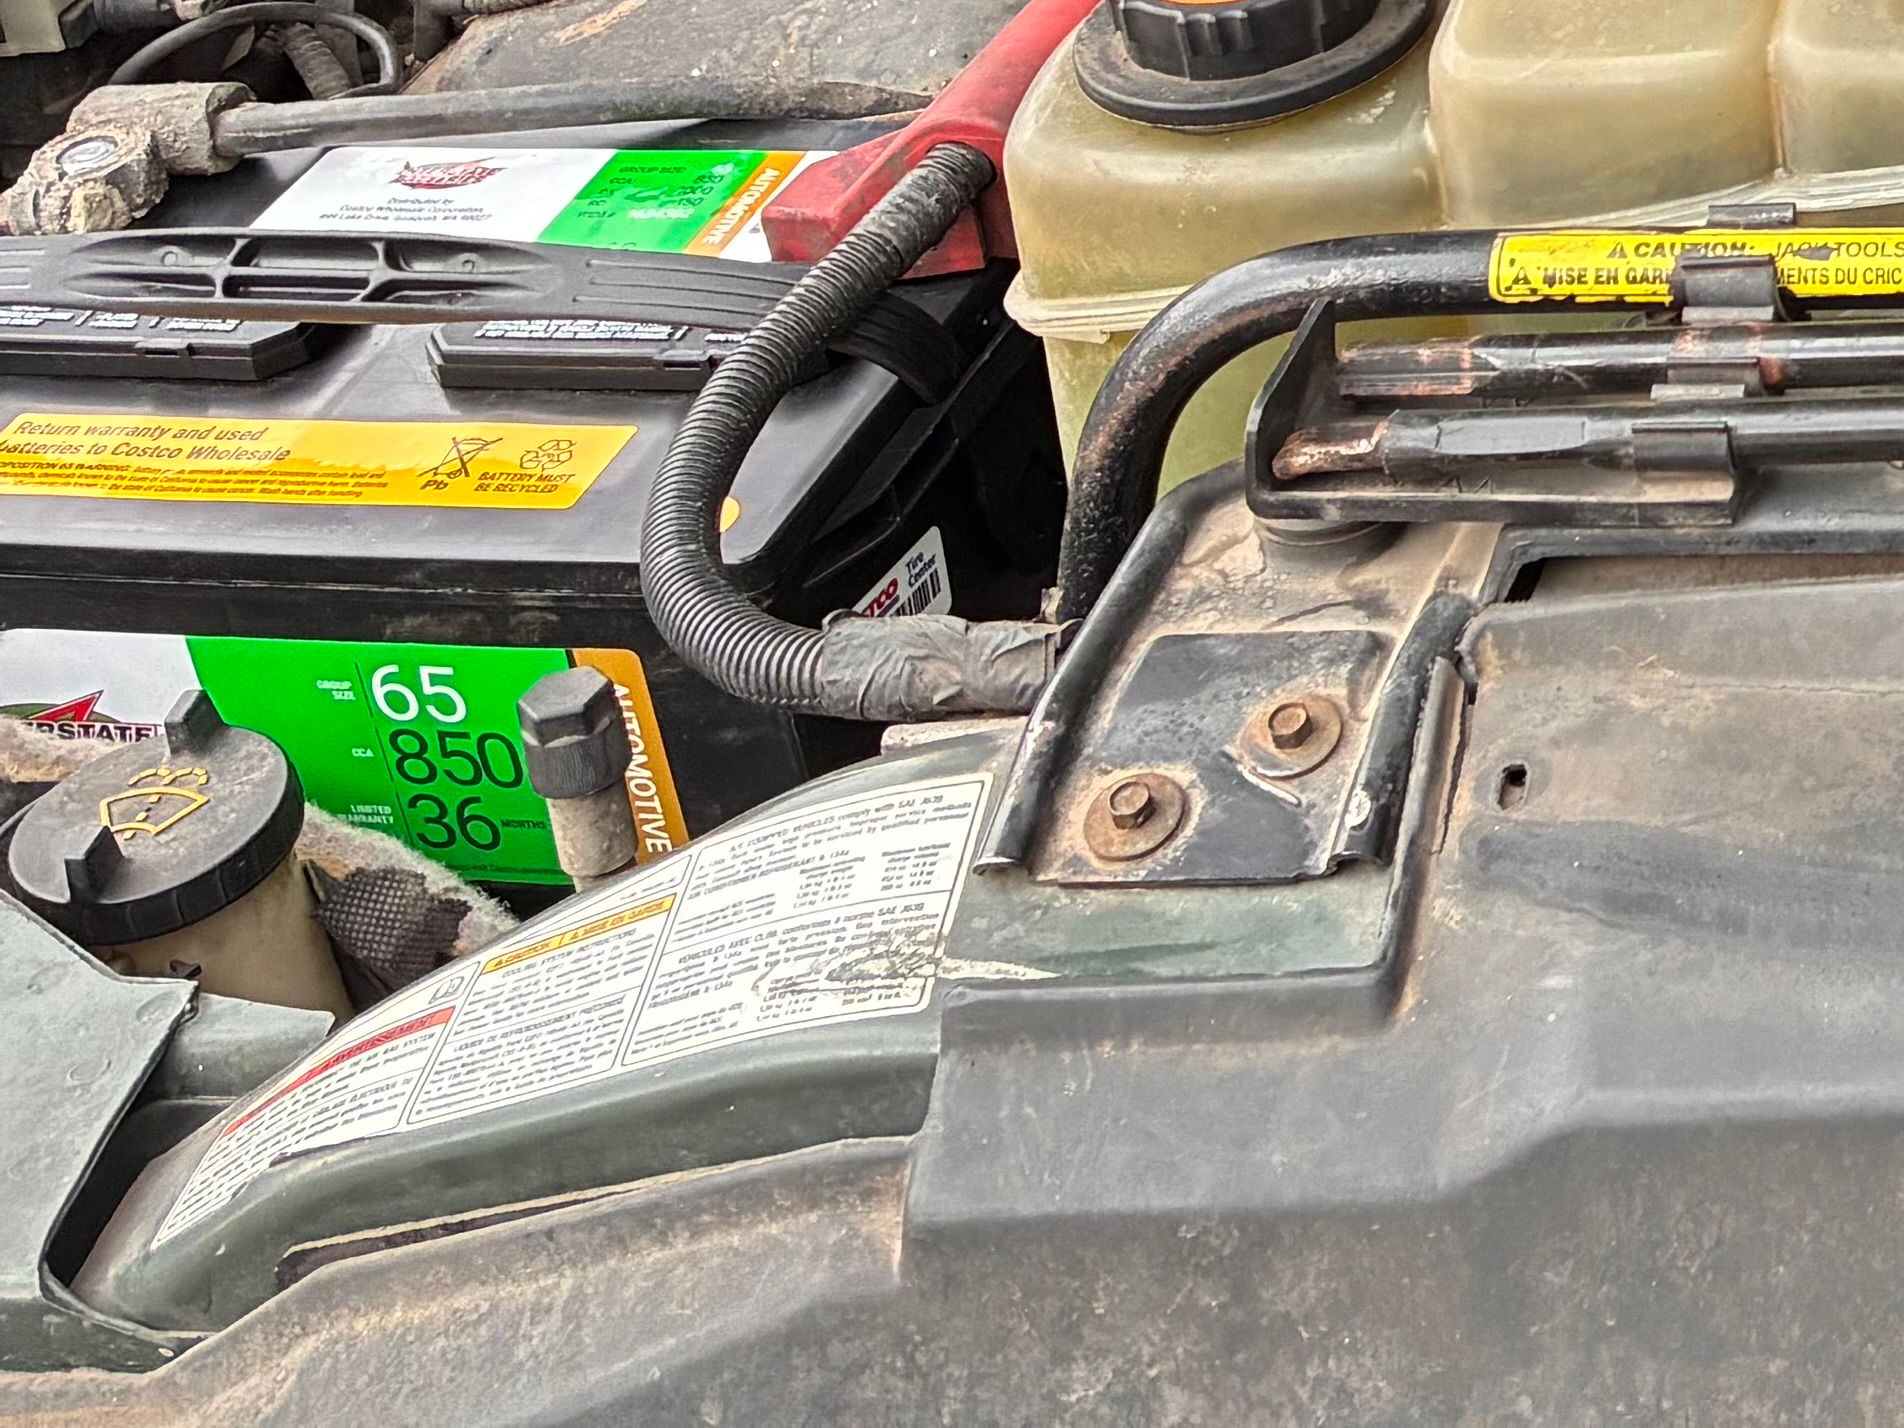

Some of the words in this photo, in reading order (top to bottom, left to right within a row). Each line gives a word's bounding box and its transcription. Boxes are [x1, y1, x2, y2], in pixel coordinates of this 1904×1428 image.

[703, 168, 781, 245] AUTOMOTIVE
[1633, 241, 1756, 258] CAUION:
[1542, 266, 1589, 285] MISE
[1594, 266, 1620, 285] EN
[1626, 266, 1672, 285] GAR
[1835, 266, 1858, 285] DU
[1864, 267, 1903, 285] CRIC
[13, 421, 82, 437] Return
[83, 424, 171, 441] warranty
[172, 425, 211, 441] and
[214, 427, 269, 442] used
[86, 442, 108, 456] to
[110, 442, 184, 459] Costco
[186, 446, 292, 462] Wholesale
[419, 479, 449, 491] Pb
[478, 471, 535, 483] BATTERY
[537, 472, 575, 484] MUST
[494, 483, 558, 494] RECYCLED
[371, 663, 467, 723] 65
[351, 748, 374, 758] CCA
[388, 728, 523, 789] 850
[407, 793, 501, 851] 36
